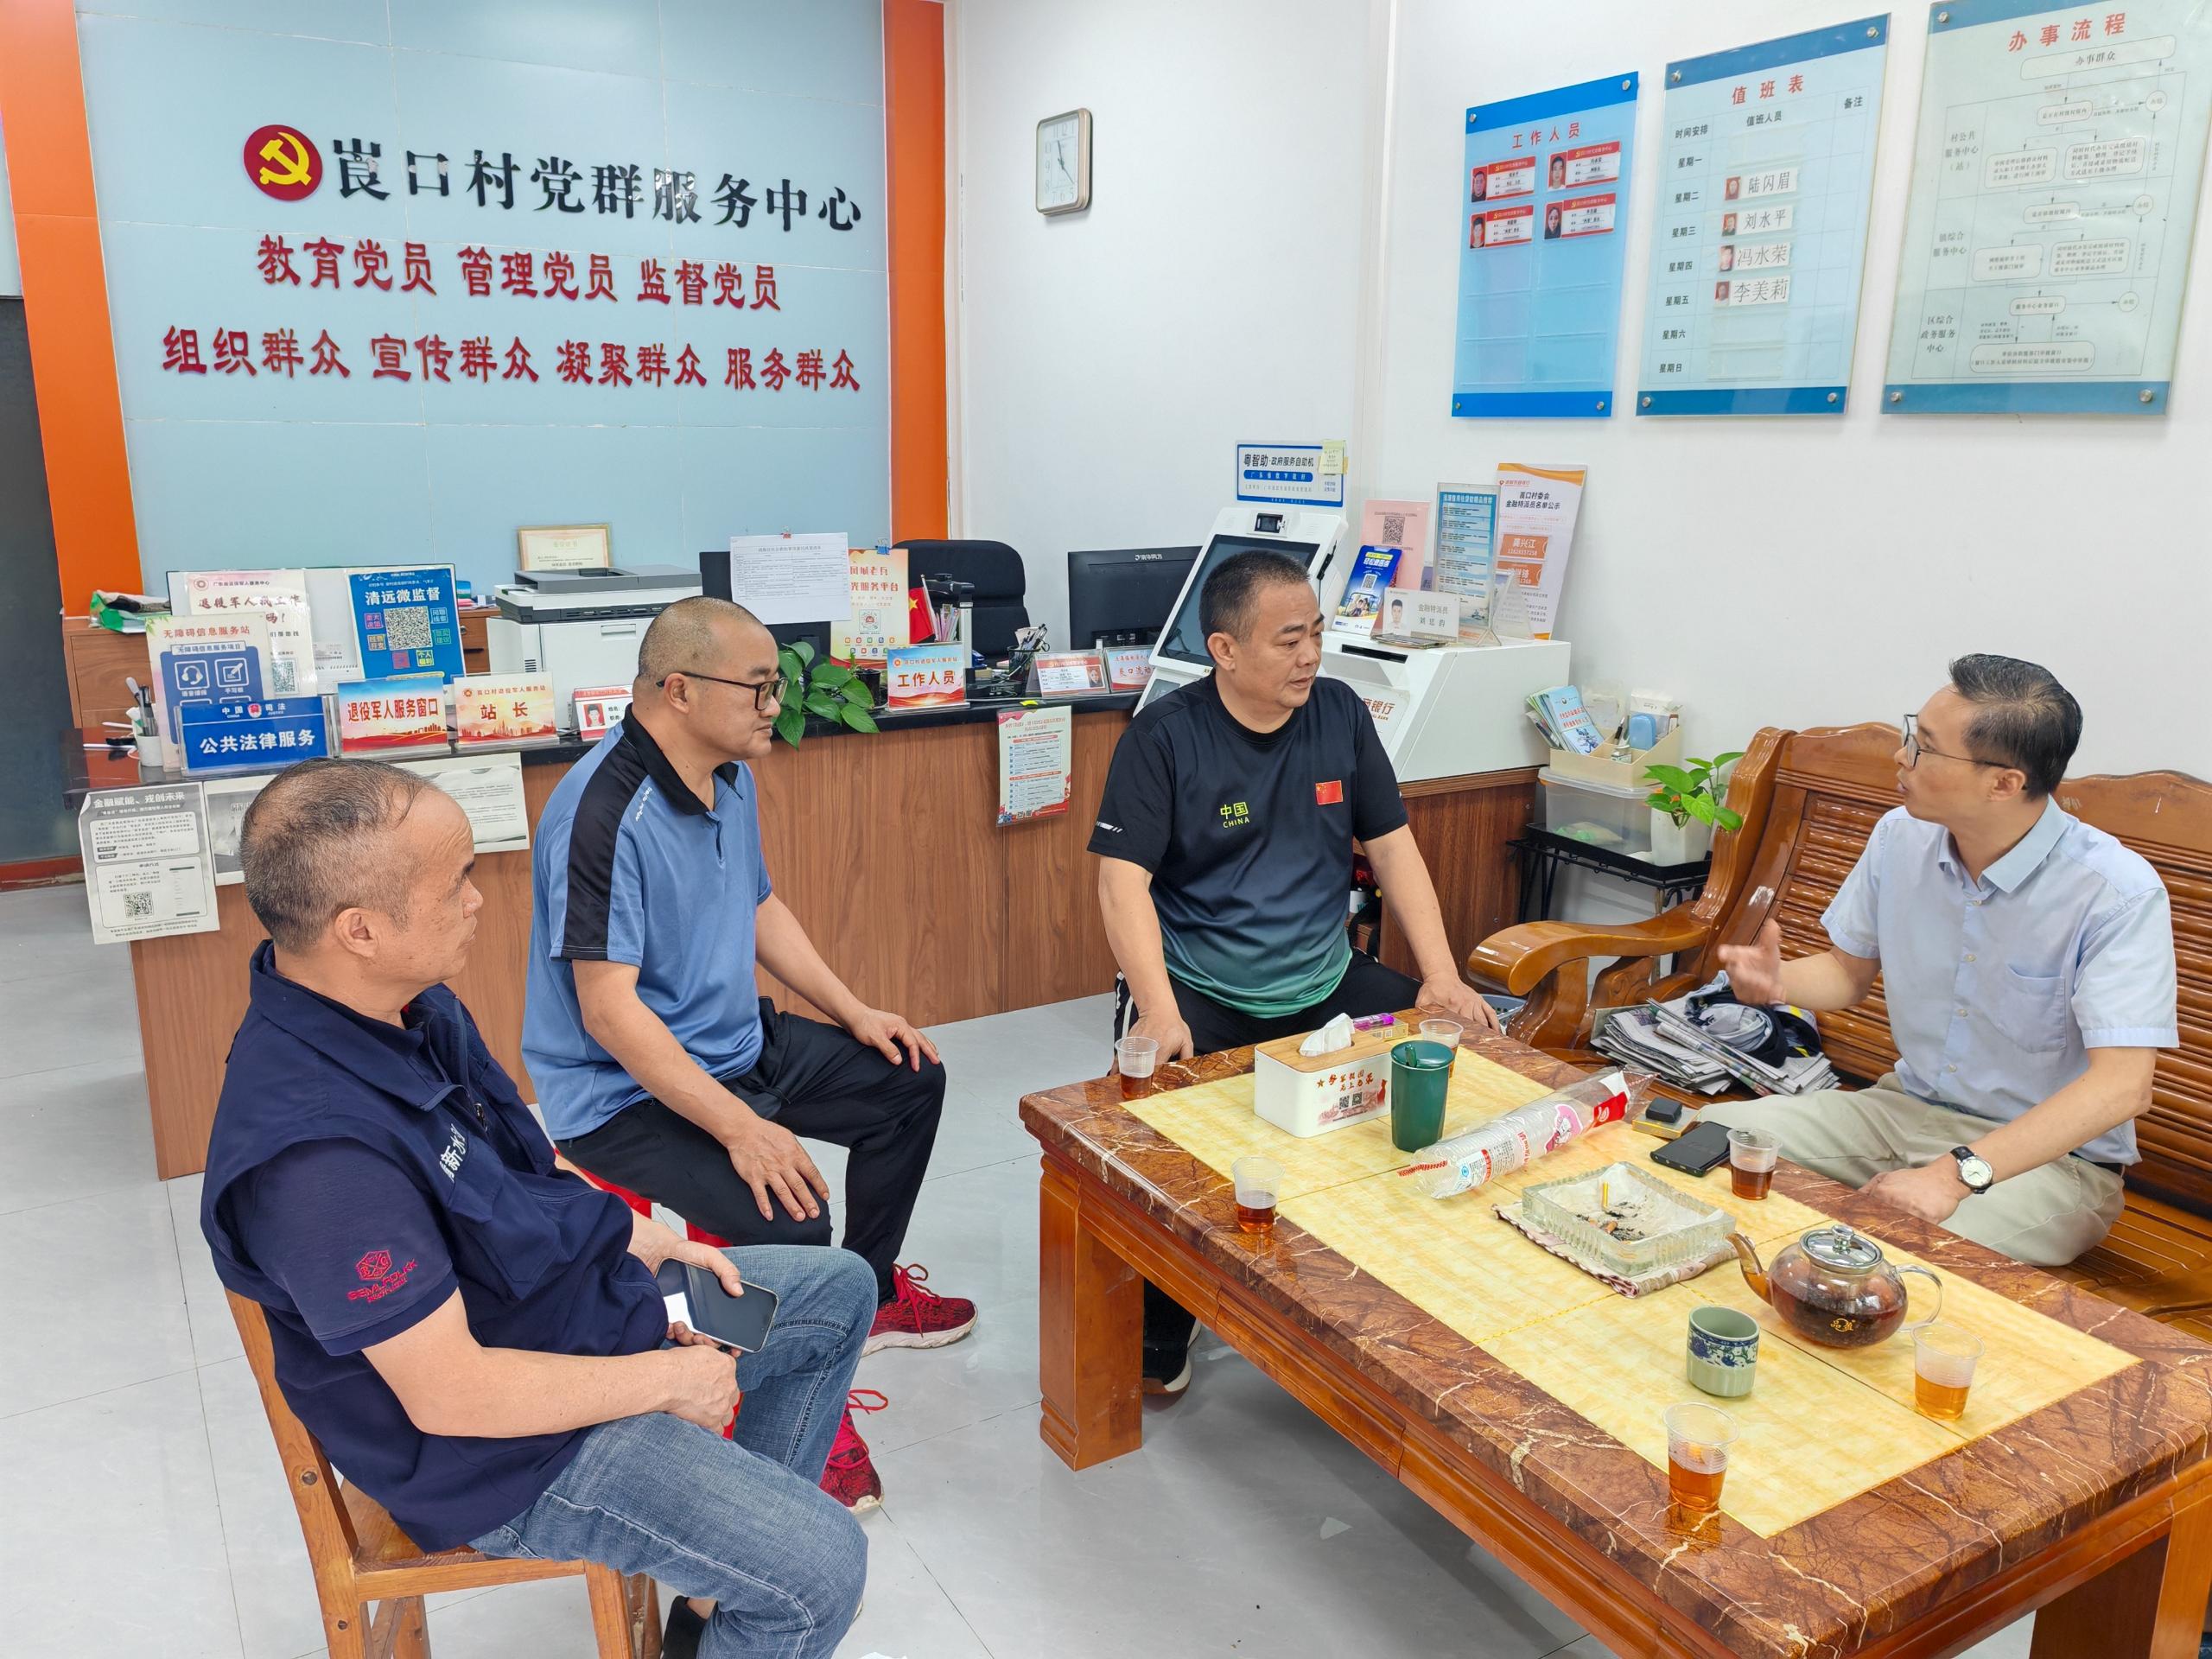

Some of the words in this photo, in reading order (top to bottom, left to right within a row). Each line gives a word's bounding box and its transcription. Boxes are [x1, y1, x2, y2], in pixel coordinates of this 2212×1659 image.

[2008, 12, 2126, 53] 办事流程
[2075, 50, 2117, 67] 办事群众
[1732, 74, 1805, 105] 值班表
[1843, 97, 1864, 110] 备注
[1745, 110, 1783, 127] 值班人员
[1512, 122, 1580, 149] 工作人员
[1675, 124, 1709, 140] 时间安排
[1677, 154, 1703, 169] 星期一
[333, 137, 861, 232] 崀口村党群服务中心
[1747, 170, 1790, 194] 陆闪眉
[1675, 190, 1700, 204] 星期二
[1744, 207, 1787, 231] 刘水平
[1671, 226, 1696, 238] 星期三
[1737, 244, 1788, 269] 冯水荣
[257, 233, 438, 296] 教育党员
[457, 245, 617, 303] 管理党员
[636, 257, 782, 312] 监督党员
[1669, 261, 1693, 274] 星期四
[1732, 277, 1789, 304] 李美莉
[1665, 295, 1689, 307] 星期五
[1662, 327, 1687, 341] 星期六
[1920, 328, 1956, 340] 政务服务
[1926, 342, 1945, 353] 中心
[162, 326, 351, 382] 组织群众
[370, 333, 540, 385] 宣传群众
[556, 341, 708, 389] 凝聚群众
[724, 346, 861, 392] 服务群众
[1658, 361, 1683, 374] 星期日
[1505, 499, 1561, 511] 金融特派员名单公示
[365, 587, 441, 606] 清远微监督
[162, 626, 251, 639] 无障碍信息服务站
[897, 670, 956, 688] 工作人员
[346, 698, 439, 724] 退役军人服务窗口
[480, 701, 529, 721] 站长
[199, 728, 316, 754] 公共法律服务
[1219, 801, 1249, 820] 中国
[1223, 817, 1250, 829] CHINA
